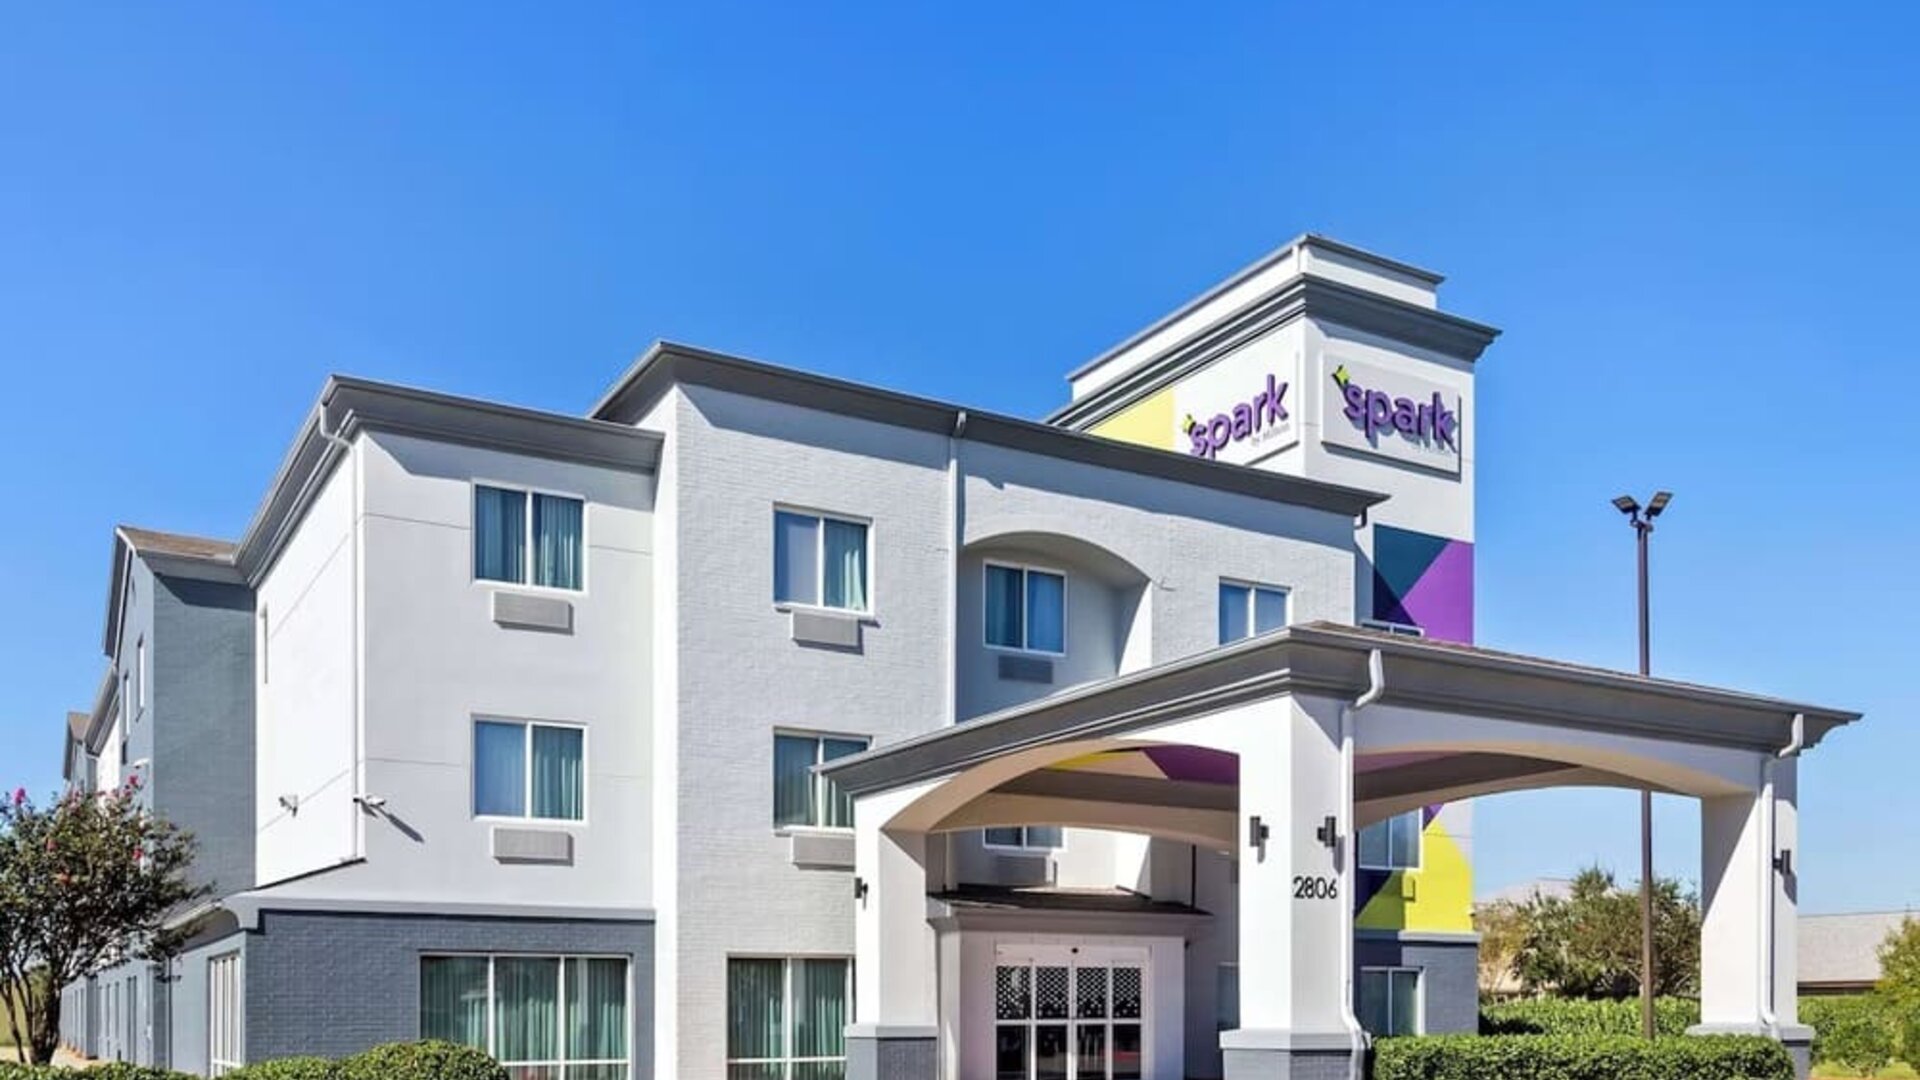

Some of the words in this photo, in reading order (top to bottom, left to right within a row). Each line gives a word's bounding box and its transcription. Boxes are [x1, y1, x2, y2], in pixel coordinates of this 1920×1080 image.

[1190, 374, 1288, 461] spark
[1343, 384, 1457, 452] spark
[1293, 876, 1337, 899] 2806
